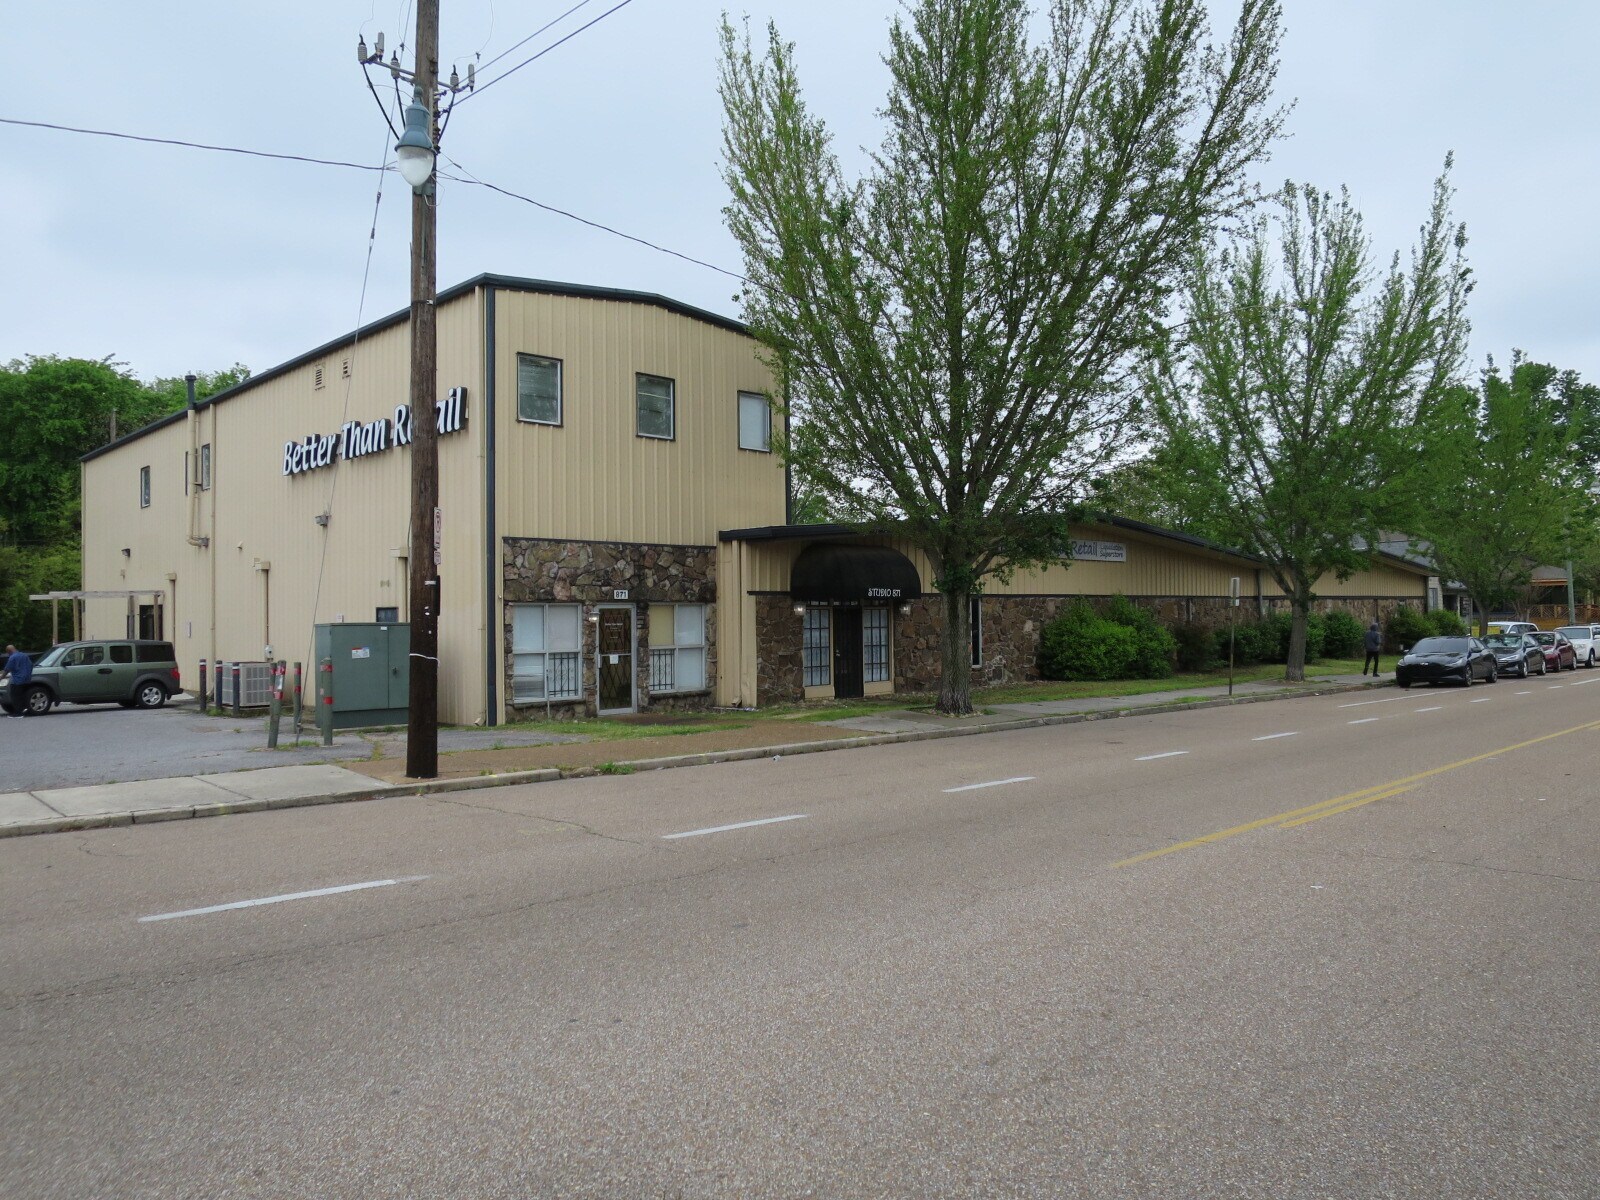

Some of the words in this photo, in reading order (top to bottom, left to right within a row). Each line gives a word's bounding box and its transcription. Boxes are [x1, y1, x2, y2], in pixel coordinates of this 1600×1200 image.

[283, 433, 339, 476] Better
[341, 418, 389, 460] Than
[393, 386, 466, 447] Rail
[1071, 541, 1098, 557] Retail
[615, 591, 627, 599] 871
[867, 588, 892, 597] STUDIO
